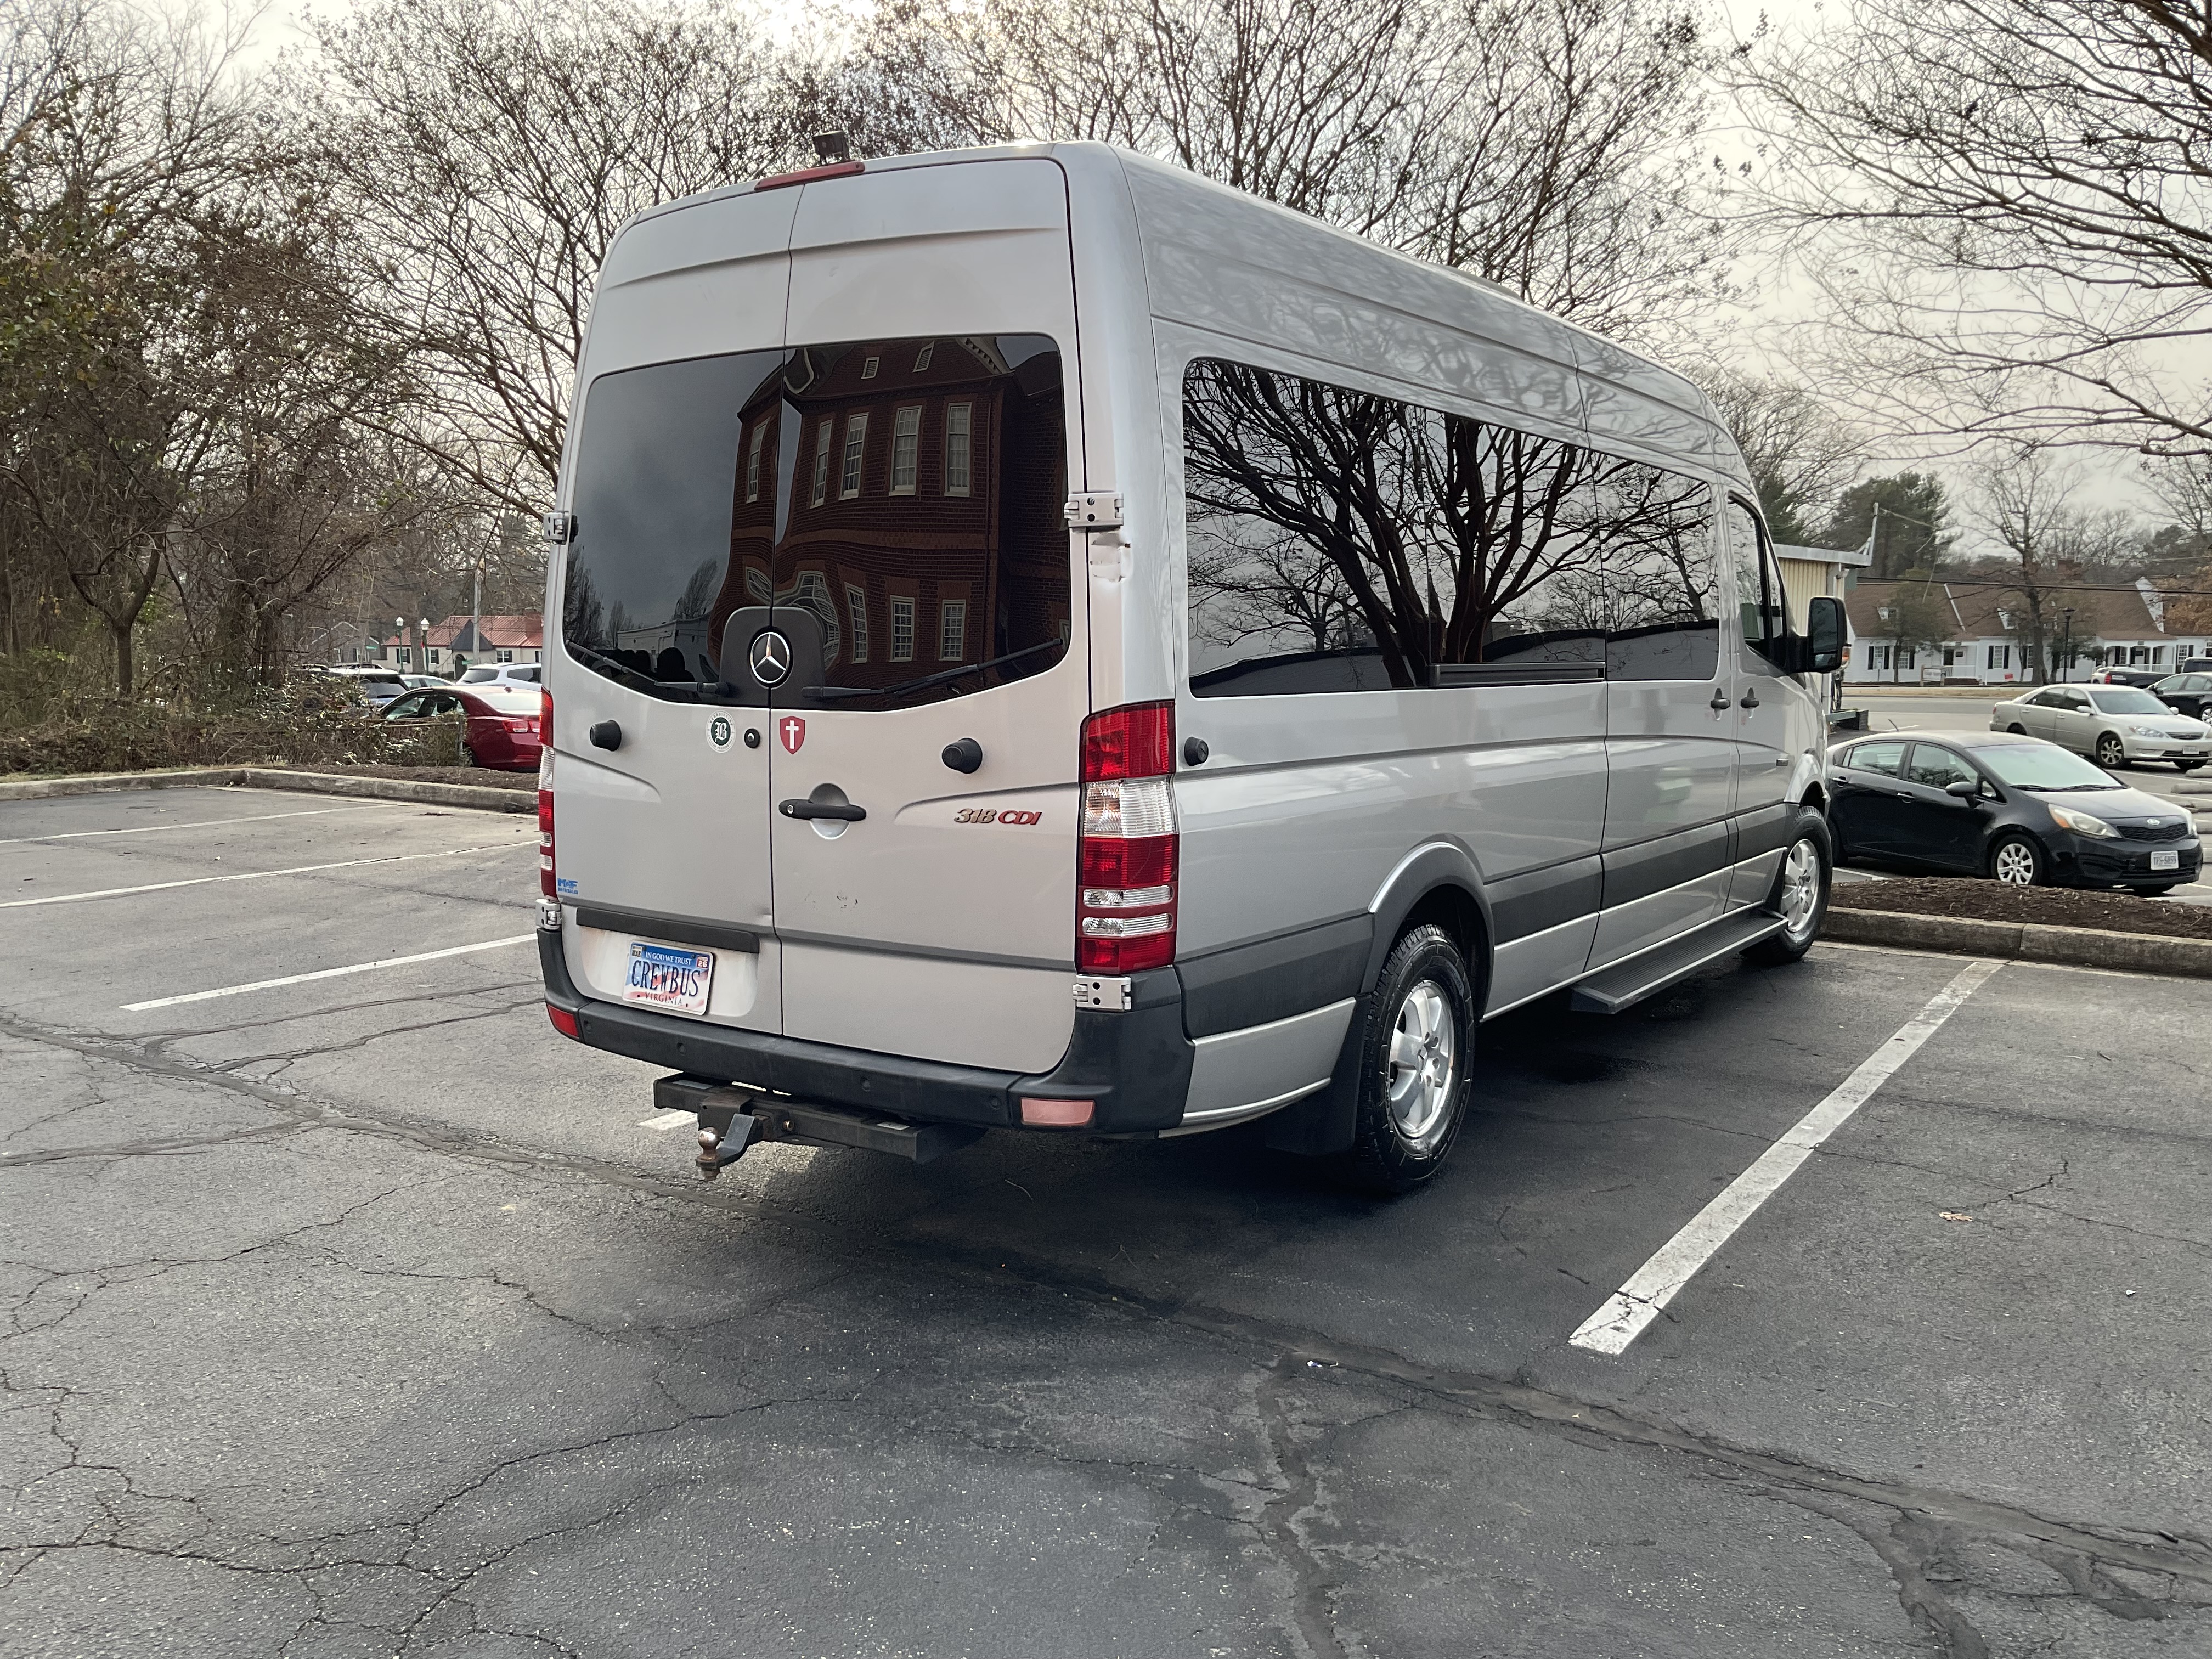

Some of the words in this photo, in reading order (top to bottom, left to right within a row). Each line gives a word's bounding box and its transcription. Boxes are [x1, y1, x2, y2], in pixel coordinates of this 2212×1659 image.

[715, 721, 727, 742] B
[953, 808, 997, 823] 318
[998, 810, 1042, 825] CDI
[675, 956, 692, 965] TRUST
[631, 960, 701, 997] CREWBUS
[645, 991, 682, 1006] VIRGINIA
